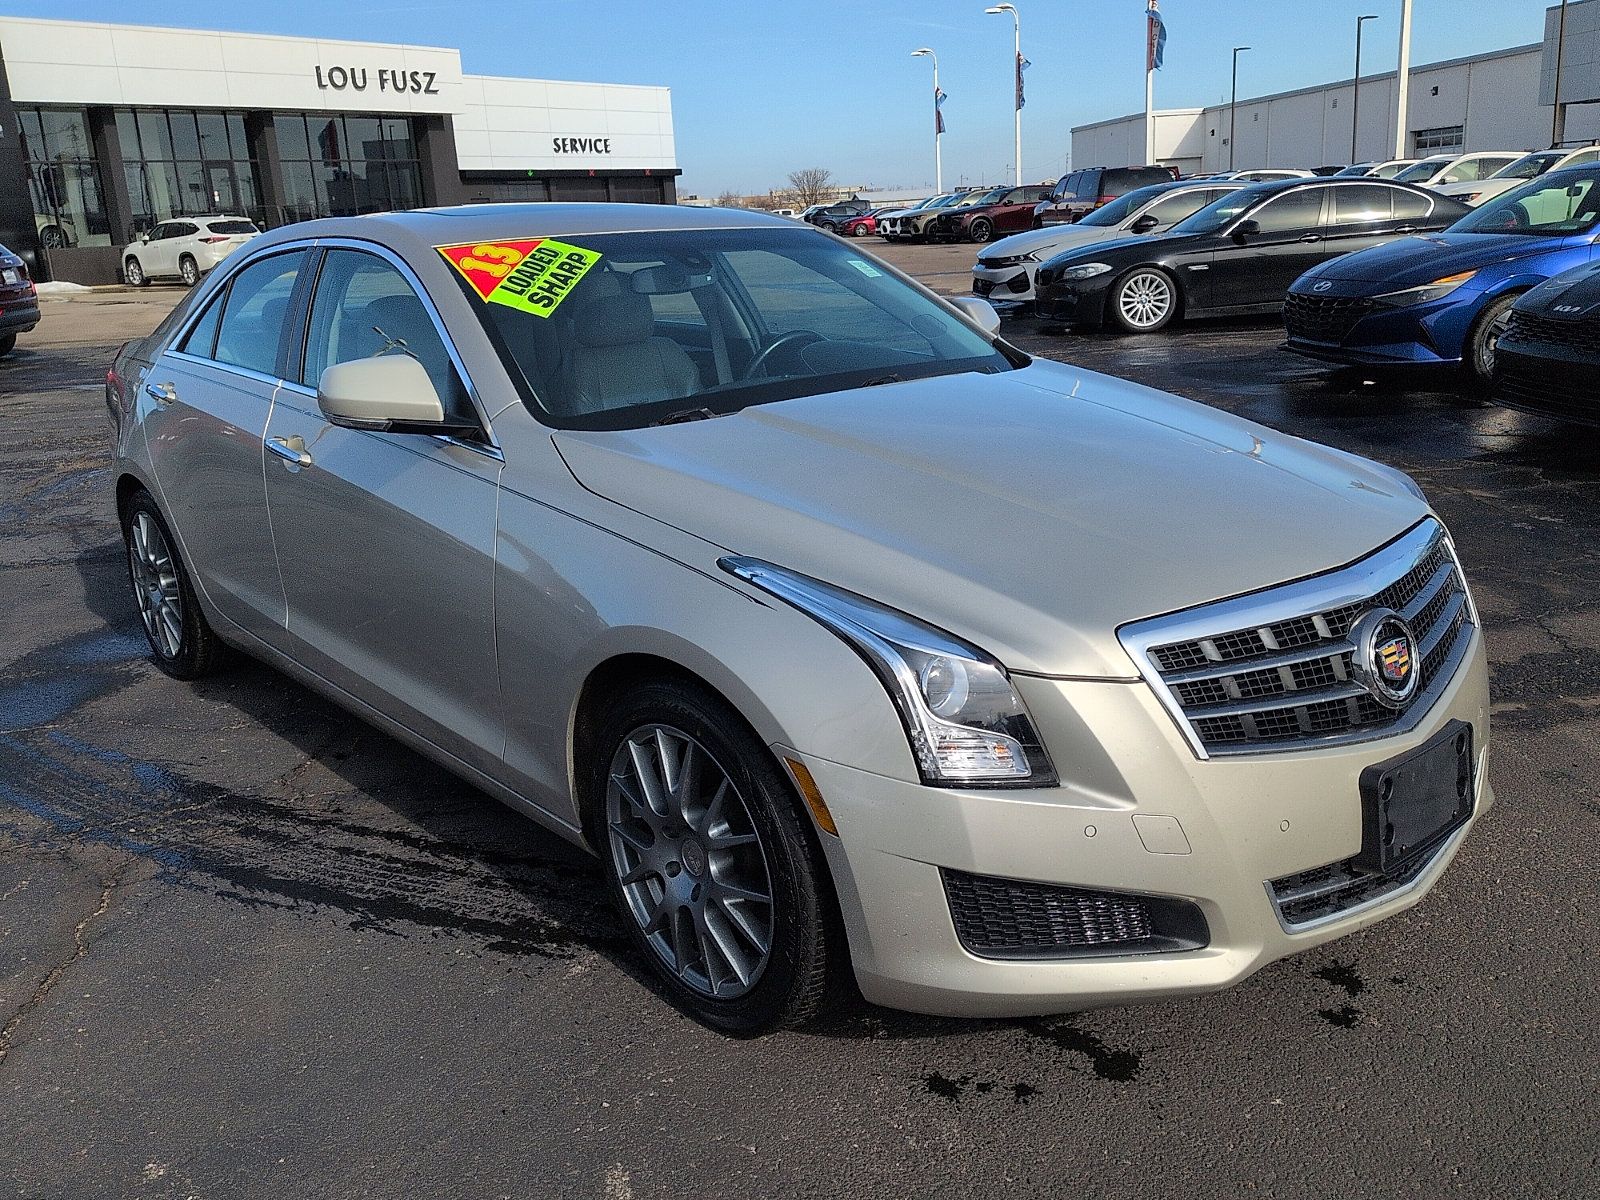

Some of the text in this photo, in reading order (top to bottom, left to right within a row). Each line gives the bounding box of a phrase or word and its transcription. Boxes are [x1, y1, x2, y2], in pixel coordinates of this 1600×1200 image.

[315, 65, 440, 95] LOU FUSZ
[553, 137, 612, 154] SERVICE
[459, 244, 524, 278] 13
[499, 246, 564, 297] LOADED
[527, 252, 590, 309] SHARP
